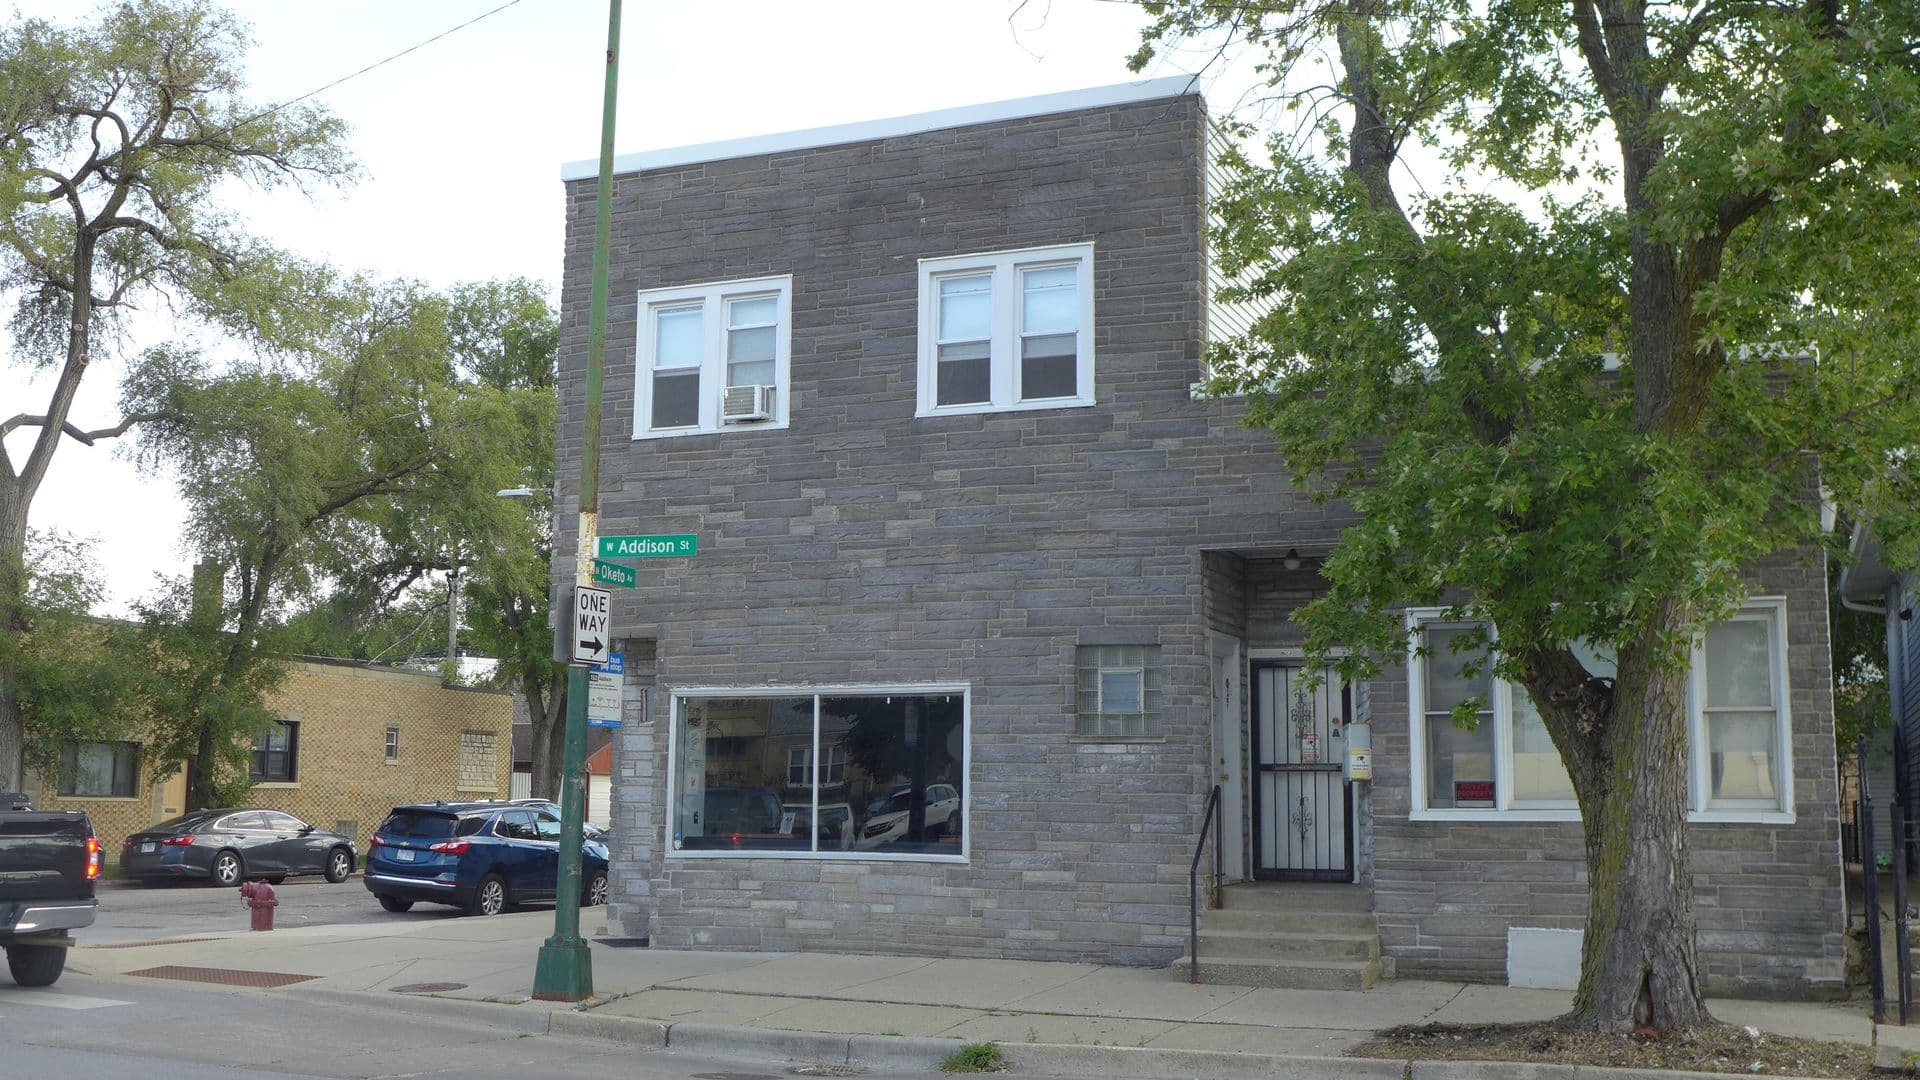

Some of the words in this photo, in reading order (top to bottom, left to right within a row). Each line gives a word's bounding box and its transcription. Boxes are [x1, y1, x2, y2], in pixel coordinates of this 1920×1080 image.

[606, 542, 614, 551] W
[618, 539, 674, 553] Addison
[680, 540, 689, 550] St
[601, 565, 625, 582] Oketo
[581, 593, 606, 613] ONE
[579, 613, 606, 632] WAY
[610, 664, 622, 673] stop
